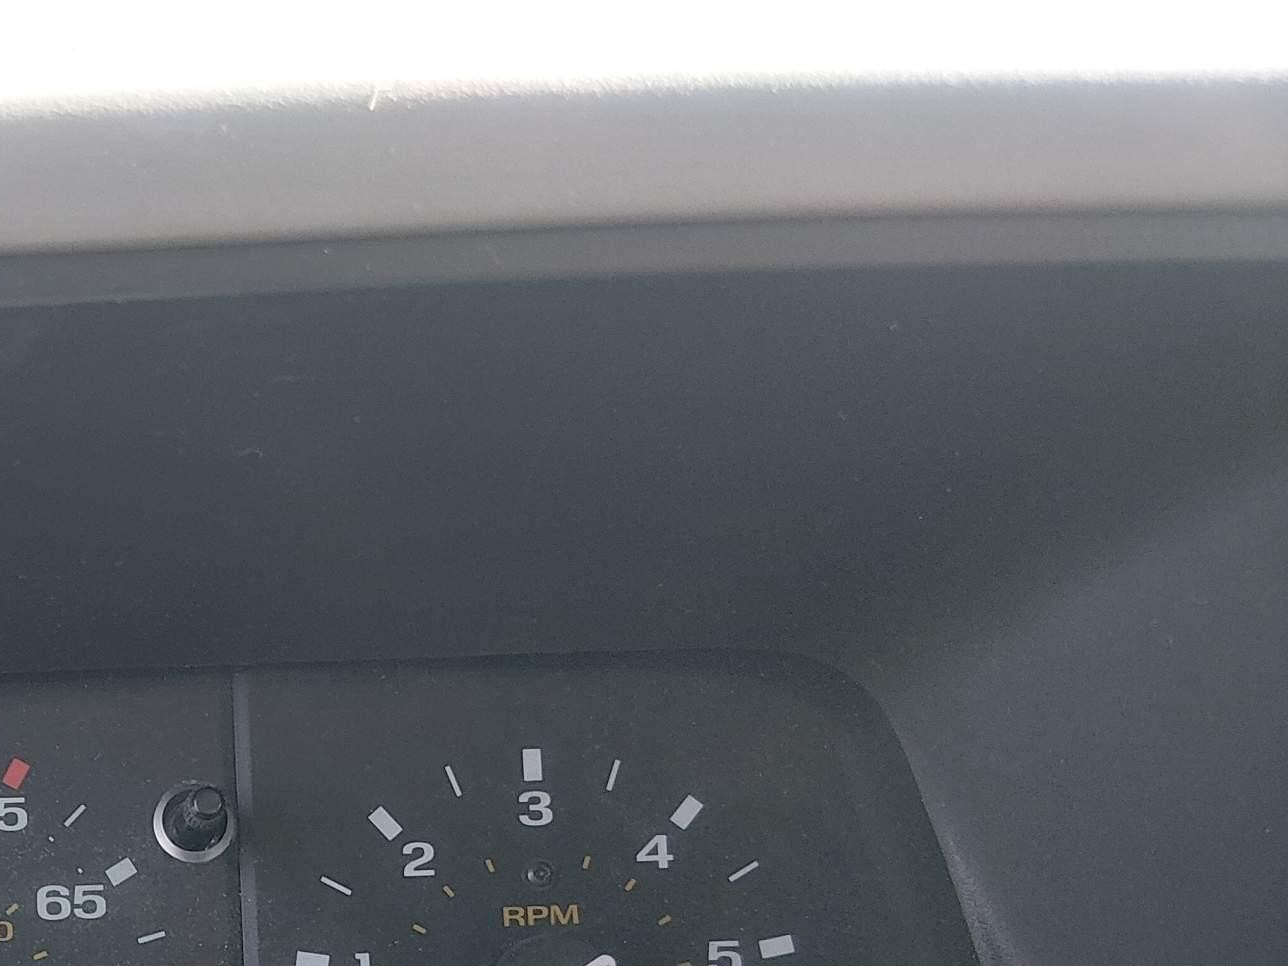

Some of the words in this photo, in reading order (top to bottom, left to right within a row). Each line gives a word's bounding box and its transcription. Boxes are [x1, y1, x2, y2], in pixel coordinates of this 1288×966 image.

[519, 791, 552, 825] 3
[403, 842, 434, 876] 2
[637, 835, 673, 868] 4
[37, 885, 106, 920] 65
[503, 905, 578, 926] RPM
